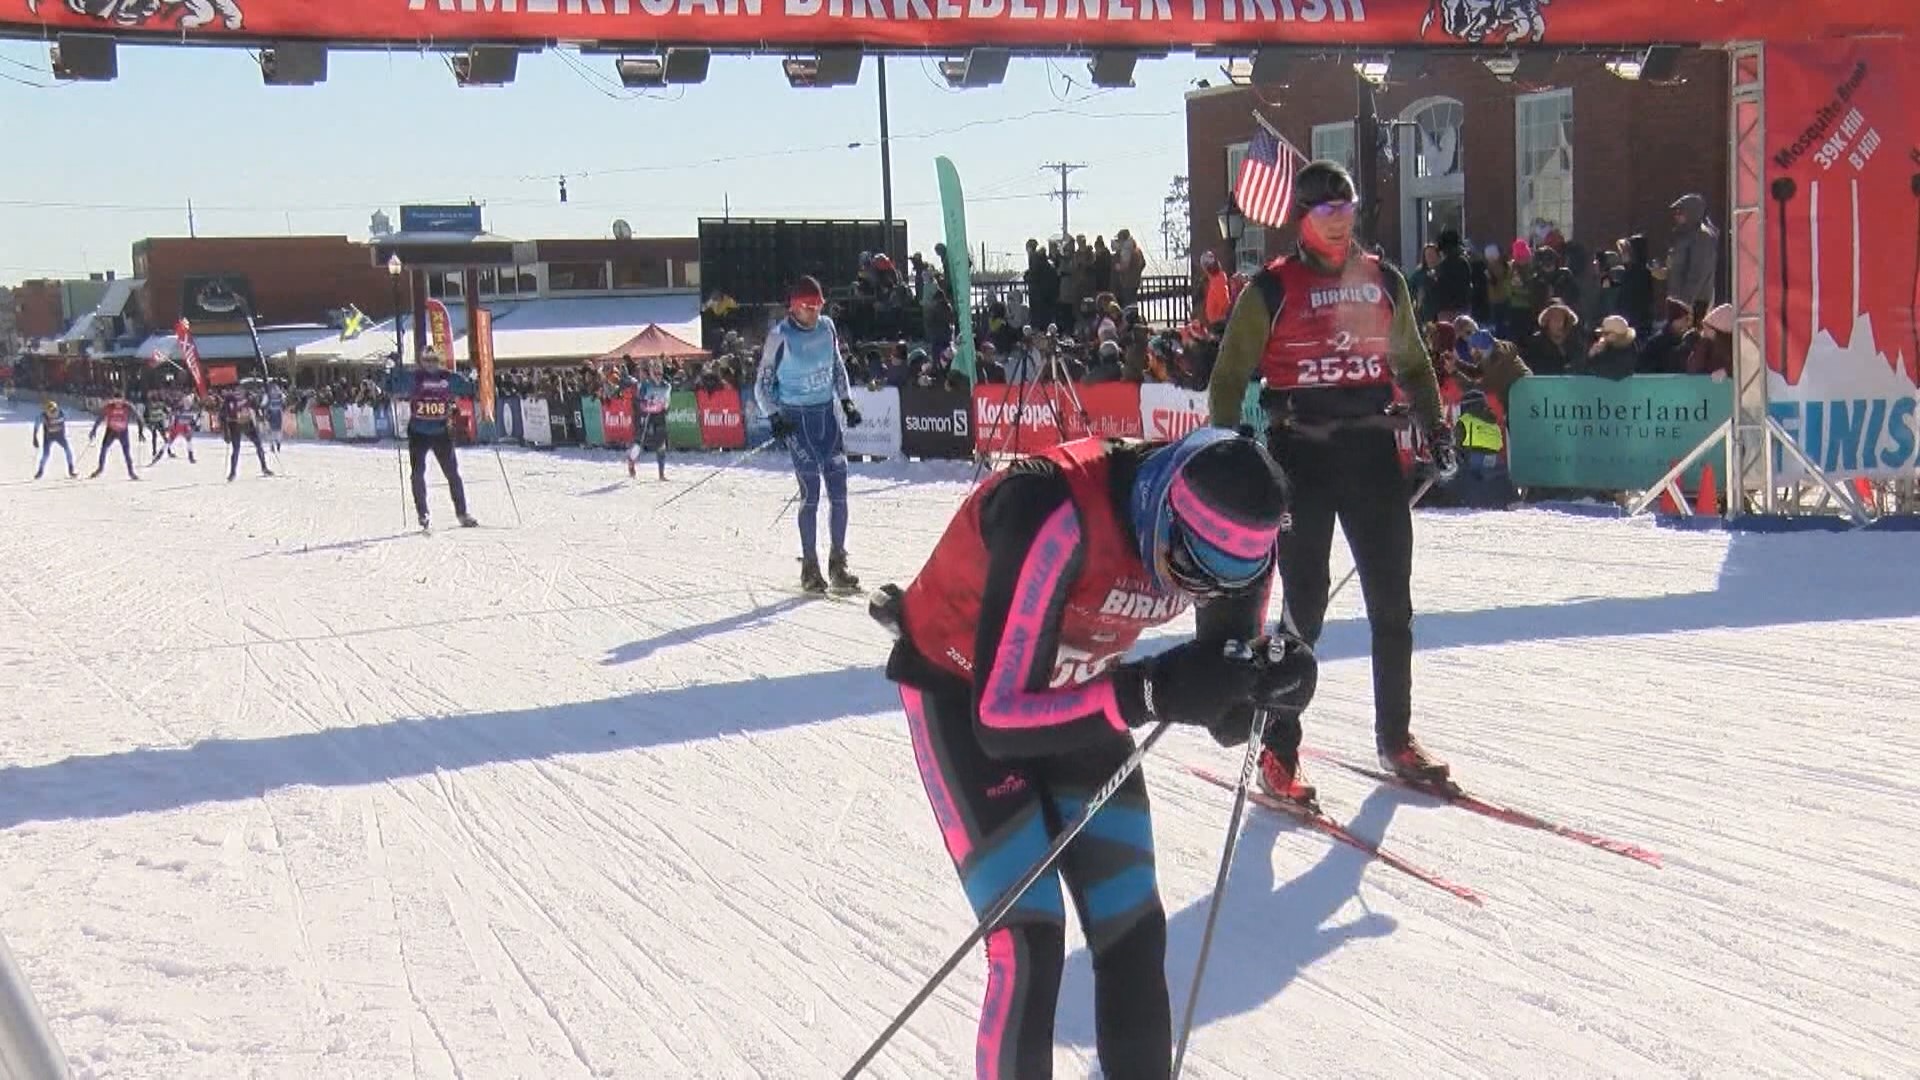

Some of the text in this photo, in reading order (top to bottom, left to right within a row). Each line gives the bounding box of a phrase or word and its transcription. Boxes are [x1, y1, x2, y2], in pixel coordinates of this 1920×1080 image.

[1813, 107, 1865, 170] 39K Hill
[1848, 127, 1882, 171] B Hill
[1297, 354, 1382, 384] 2536
[416, 402, 446, 415] 2108
[1530, 397, 1708, 421] slumberland
[905, 415, 951, 432] salomon
[1554, 425, 1681, 438] FURNITURE
[1769, 396, 1920, 472] FINIS
